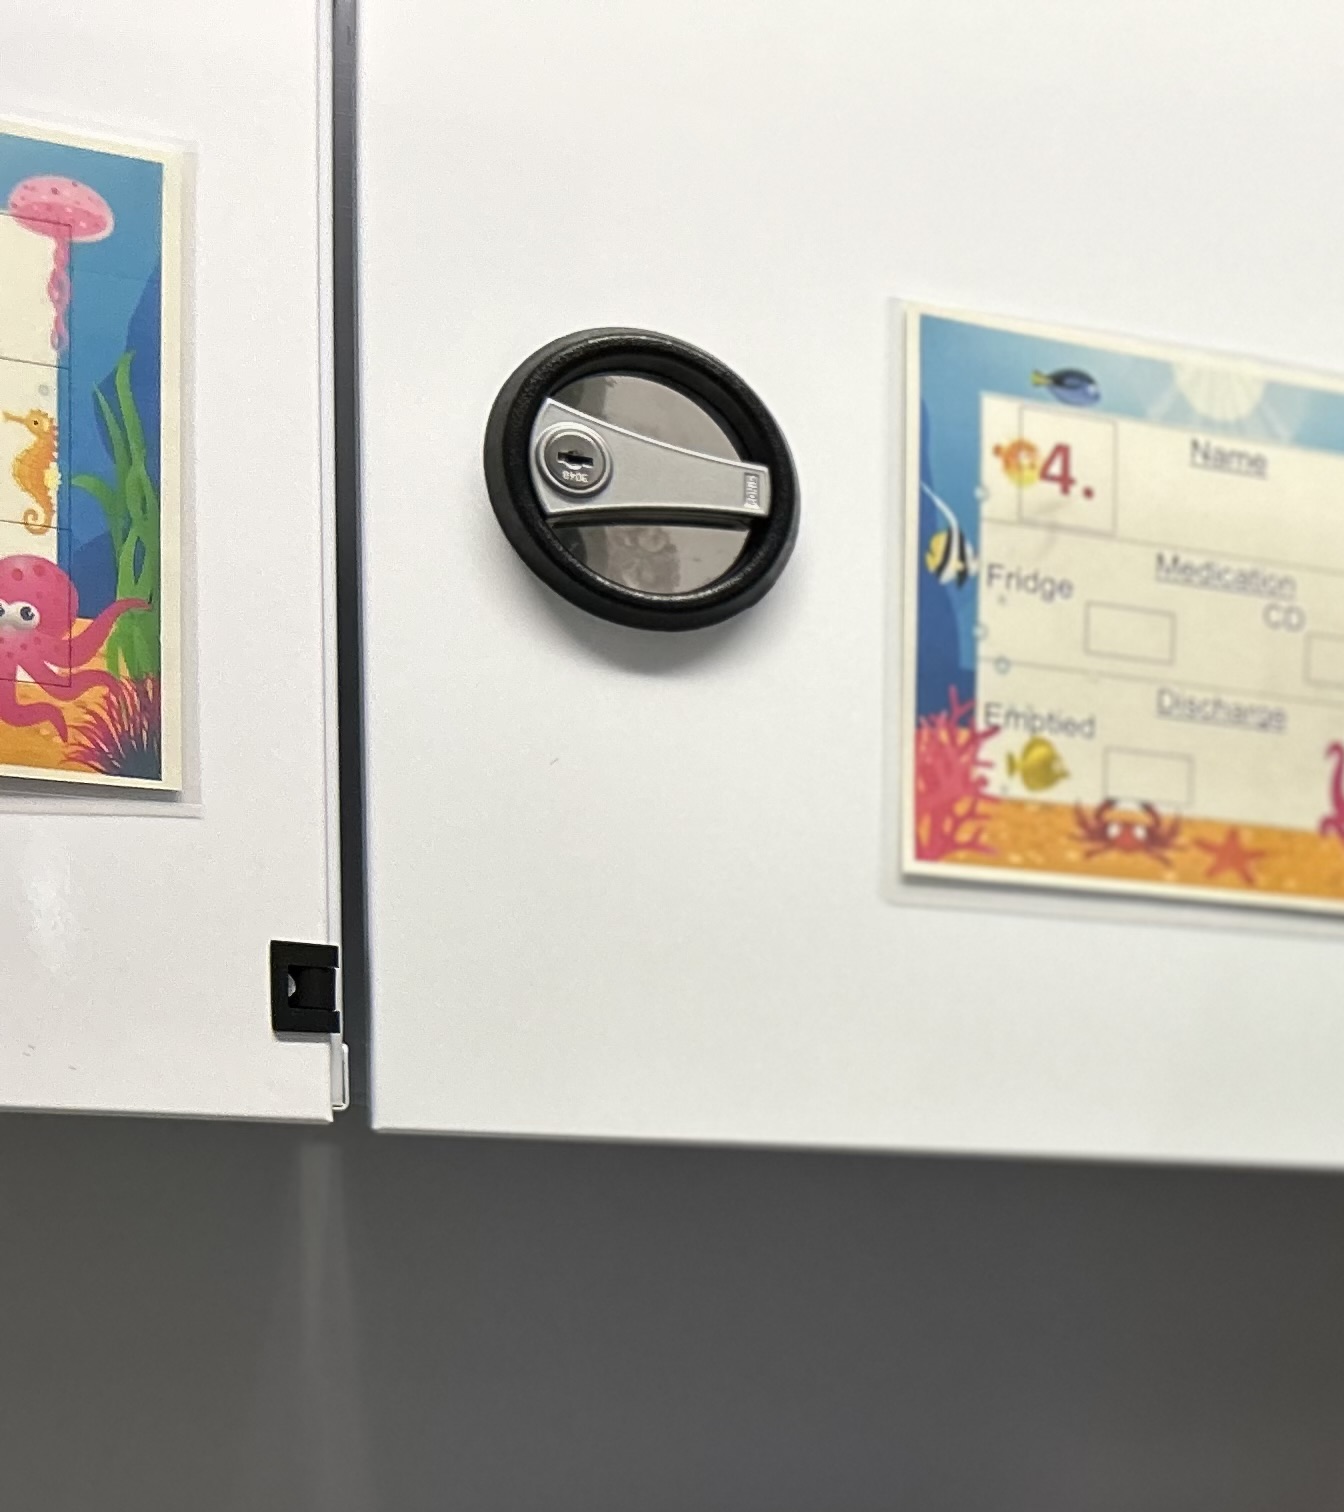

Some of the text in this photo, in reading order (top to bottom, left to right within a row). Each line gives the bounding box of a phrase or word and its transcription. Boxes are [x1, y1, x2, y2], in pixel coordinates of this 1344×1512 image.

[1039, 443, 1095, 500] 4.
[1190, 438, 1268, 480] Name
[986, 563, 1074, 603] Fridge
[1155, 553, 1297, 601] Medication
[984, 703, 1096, 741] Emptied
[1155, 687, 1287, 735] Discharge
